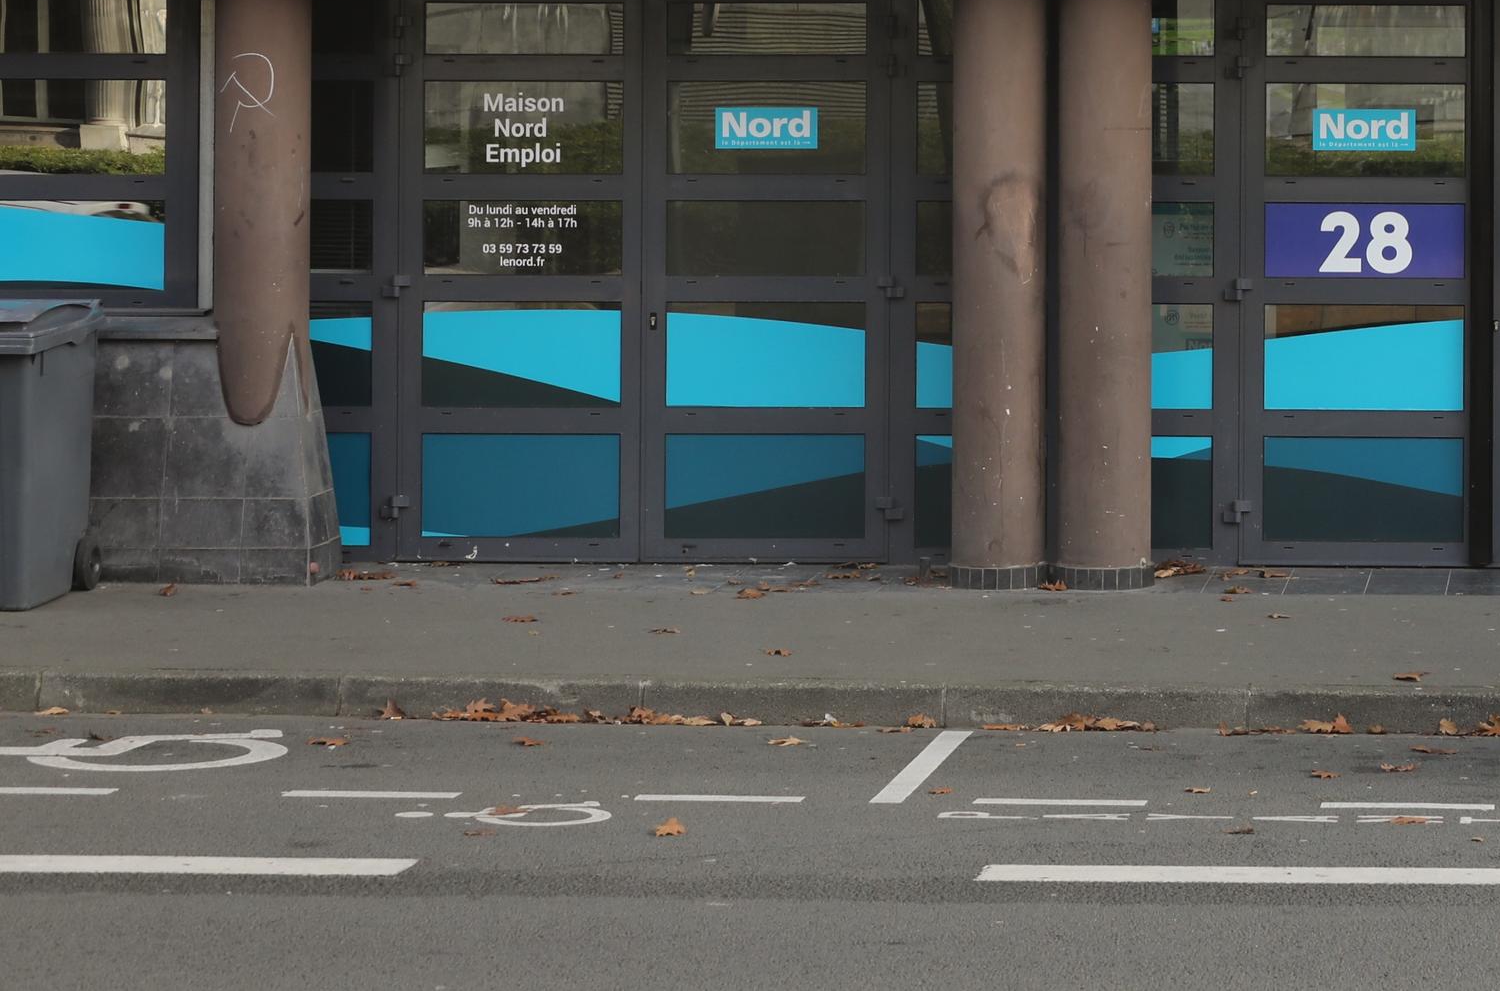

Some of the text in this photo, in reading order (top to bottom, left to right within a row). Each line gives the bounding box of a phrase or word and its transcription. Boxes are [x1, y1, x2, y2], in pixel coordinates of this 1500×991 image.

[483, 92, 564, 113] Maison
[494, 116, 547, 138] Nord
[722, 109, 811, 138] Nord
[1319, 111, 1409, 140] Nord
[485, 142, 561, 168] Emploi
[468, 204, 577, 215] Du lundi au vendredi
[467, 217, 482, 228] 9h
[484, 216, 491, 228] à
[495, 217, 514, 228] 12h
[525, 217, 545, 228] 14h
[547, 216, 555, 228] à
[557, 217, 578, 228] 17h
[482, 243, 563, 254] 03 59 73 73 59
[1318, 211, 1413, 274] 28
[499, 255, 545, 267] lenord.fr
